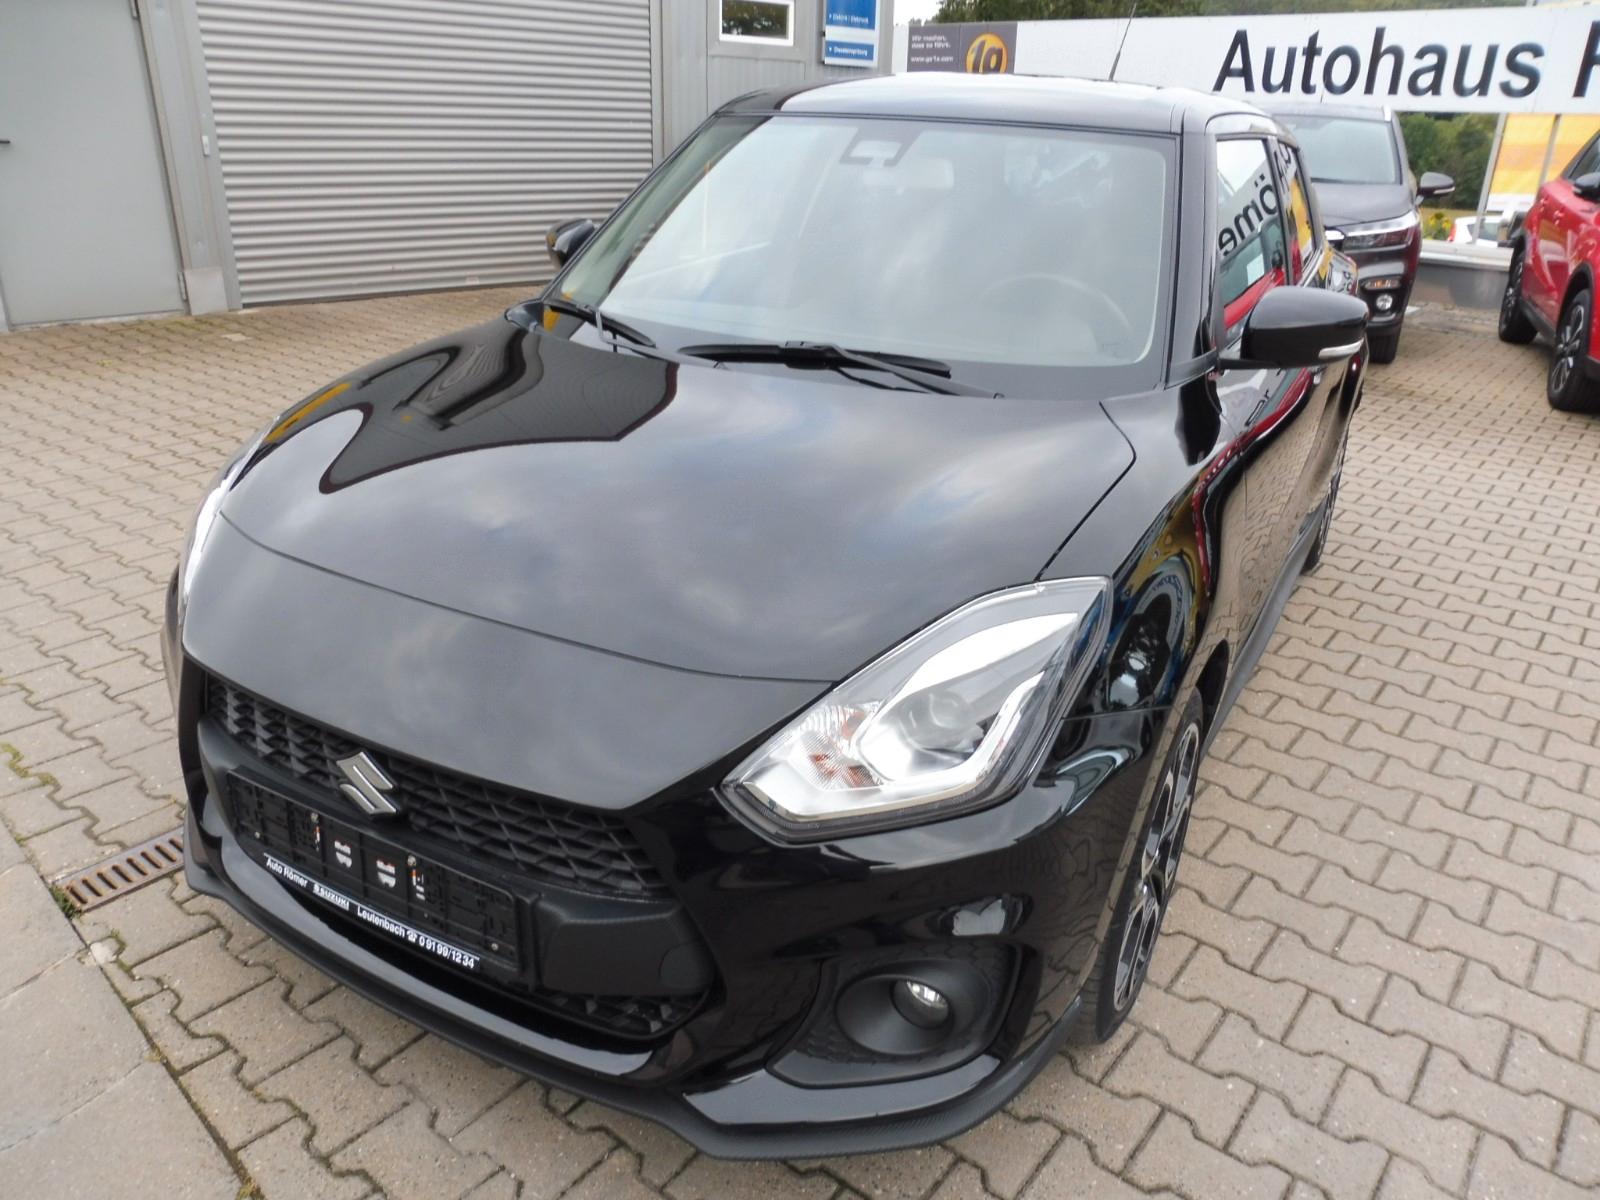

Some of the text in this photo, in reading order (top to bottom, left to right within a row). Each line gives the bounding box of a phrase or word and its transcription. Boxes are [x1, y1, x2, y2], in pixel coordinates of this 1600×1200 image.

[1212, 26, 1545, 98] Autohaus
[266, 857, 283, 875] Auto
[357, 905, 405, 938] Leutenbach
